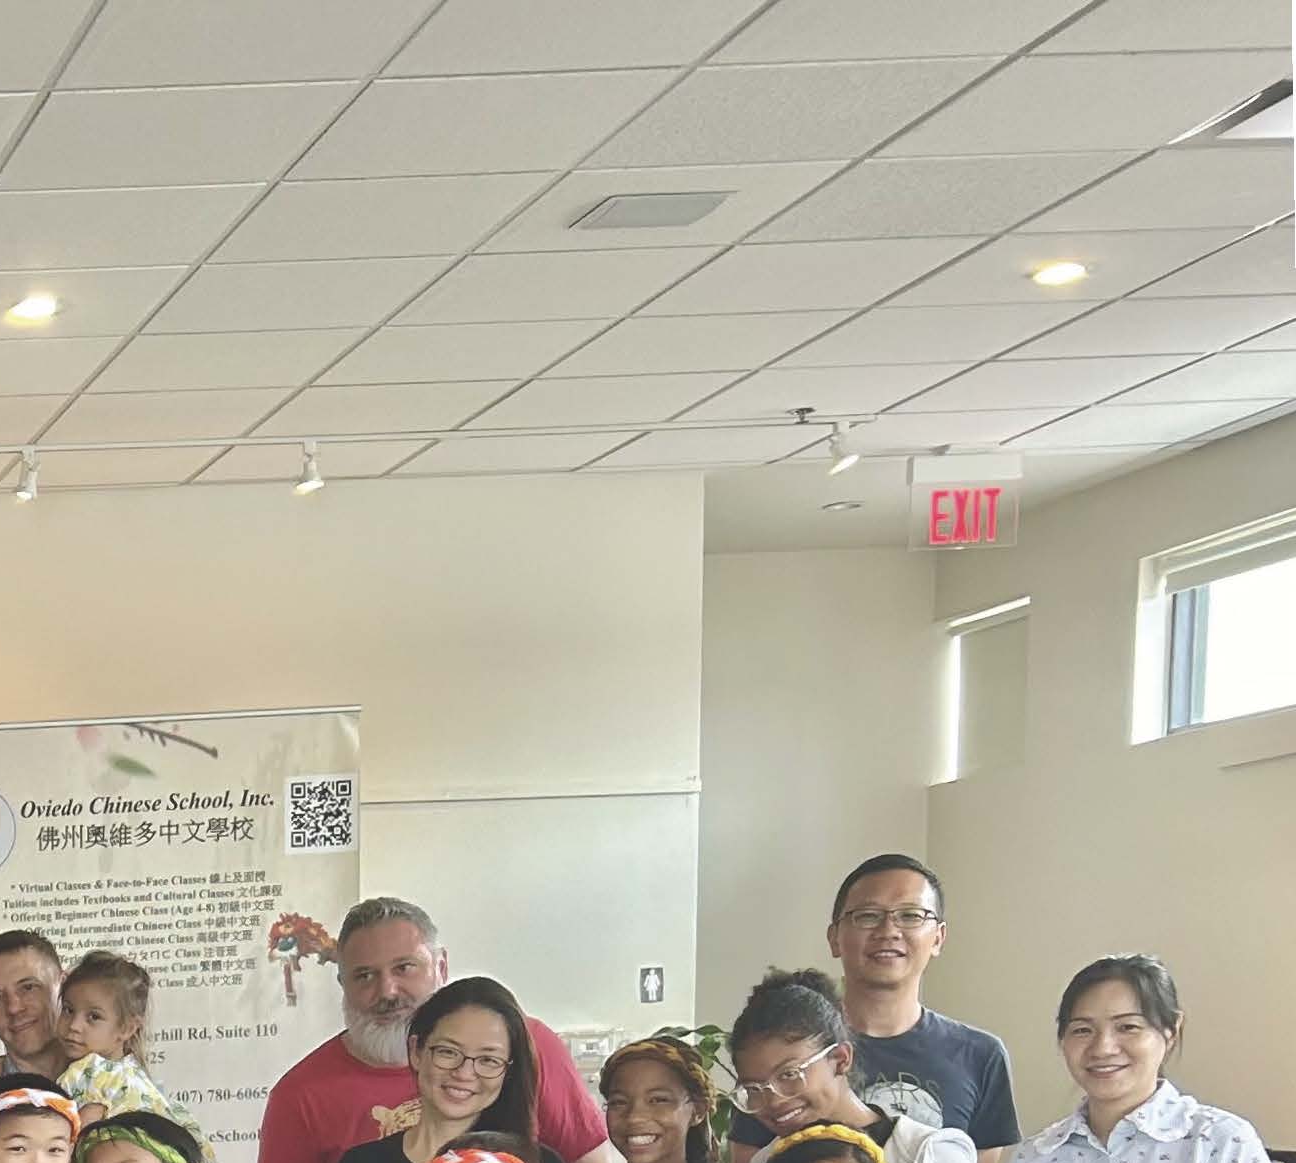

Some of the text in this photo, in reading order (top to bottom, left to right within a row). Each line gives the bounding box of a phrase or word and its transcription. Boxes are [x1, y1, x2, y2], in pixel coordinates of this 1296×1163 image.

[930, 488, 1002, 543] EXIT
[20, 788, 275, 819] Oviedo Chinese School, Inc.
[36, 816, 254, 851] 佛州奧維多中文學校
[18, 883, 53, 893] Virtual
[55, 881, 91, 891] Classes
[107, 878, 169, 889] Face-to-Face
[171, 875, 207, 886] Classes
[3, 899, 36, 910] Tuition
[40, 897, 79, 908] includes
[82, 894, 131, 905] Textbooks
[133, 893, 152, 902] and
[155, 890, 196, 901] Cultural
[198, 888, 235, 898] Classes
[10, 911, 52, 923] Offering
[55, 908, 98, 921] Beginner
[101, 907, 139, 918] Chinese
[142, 905, 168, 916] Class
[171, 903, 194, 916] (Age
[69, 922, 131, 935] Intermediate
[134, 921, 172, 932] Chinese
[175, 919, 201, 929] Class
[76, 936, 124, 948] Advanced
[126, 934, 167, 945] Chinese
[169, 933, 194, 943] Class
[175, 948, 201, 958] Class
[171, 961, 197, 972] Class
[158, 977, 184, 988] Class
[188, 1027, 212, 1041] Rd,
[216, 1025, 251, 1039] Suite
[256, 1023, 278, 1037] 110
[207, 1086, 269, 1101] 780-6065
